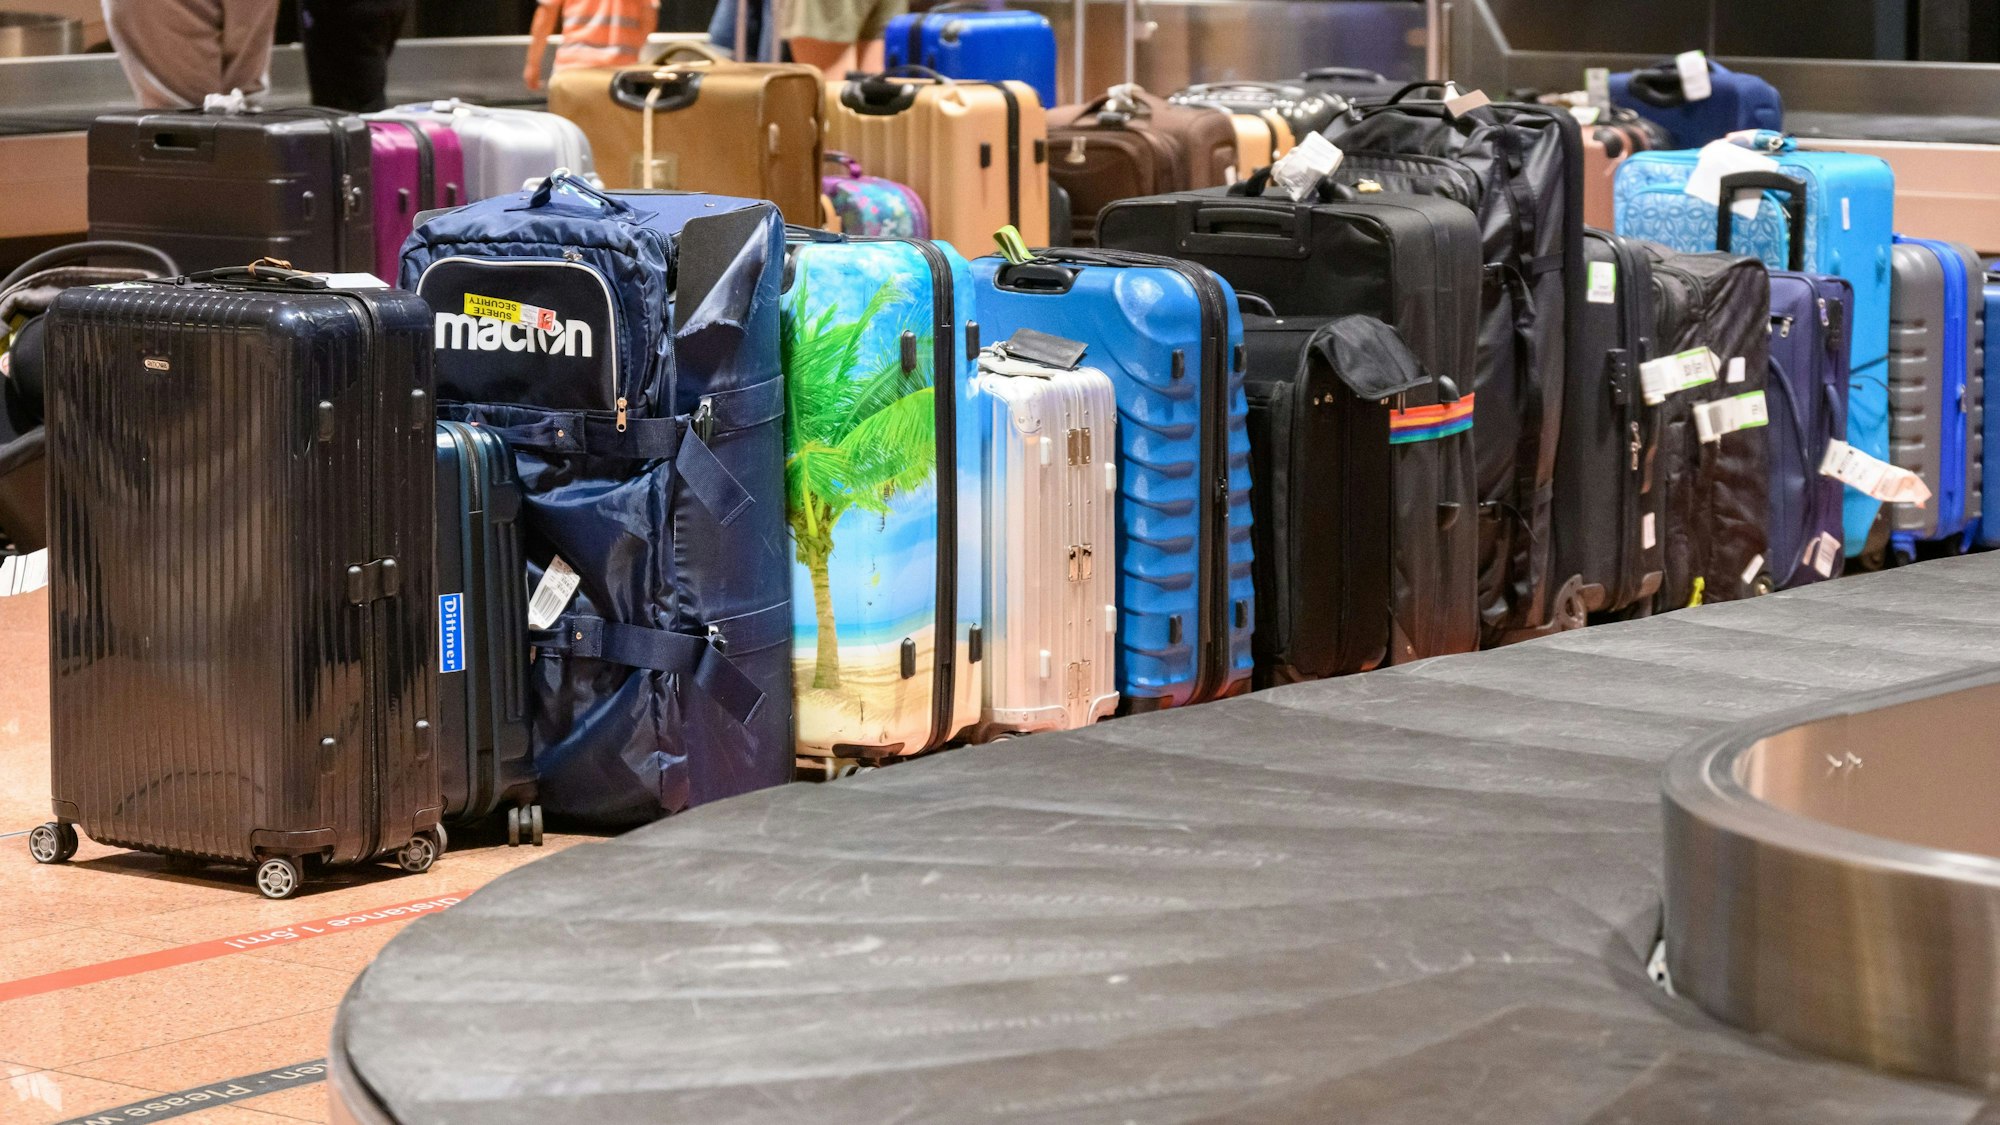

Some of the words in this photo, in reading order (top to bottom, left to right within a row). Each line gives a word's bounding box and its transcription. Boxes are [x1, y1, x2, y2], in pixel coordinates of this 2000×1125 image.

[468, 296, 517, 311] SECURITY
[473, 307, 512, 320] SURETE
[444, 597, 457, 670] Dittmer
[328, 897, 462, 927] distance
[124, 1084, 253, 1118] Please
